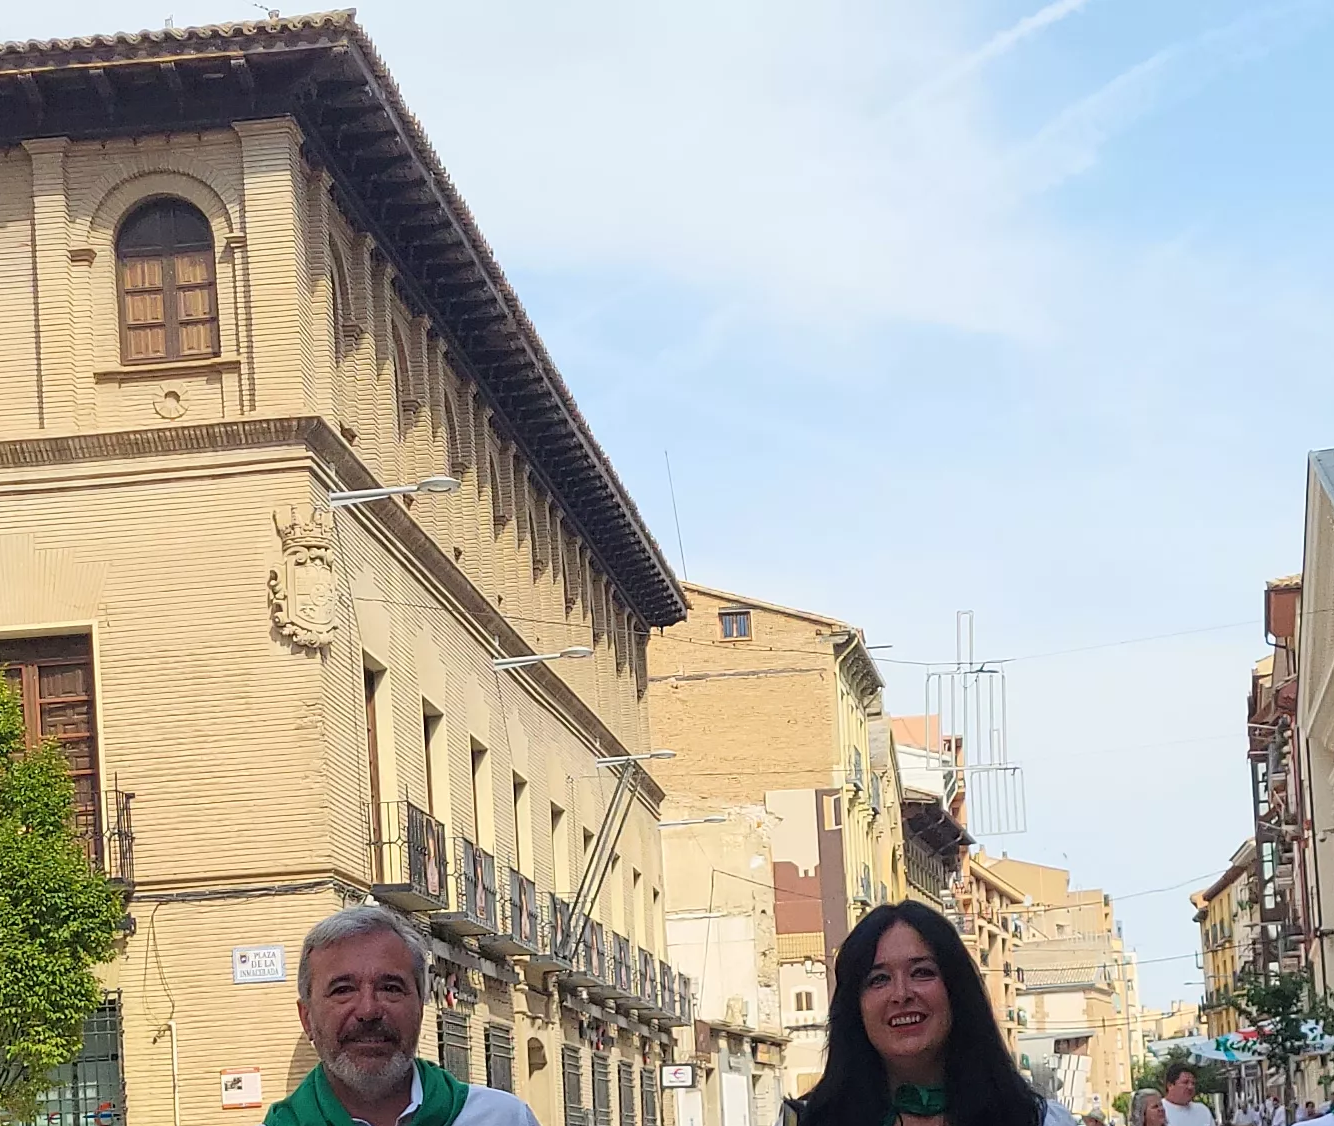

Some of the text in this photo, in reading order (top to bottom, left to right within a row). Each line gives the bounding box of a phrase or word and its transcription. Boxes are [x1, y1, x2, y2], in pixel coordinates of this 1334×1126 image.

[253, 951, 277, 960] PLAZA
[251, 959, 275, 969] DE LA
